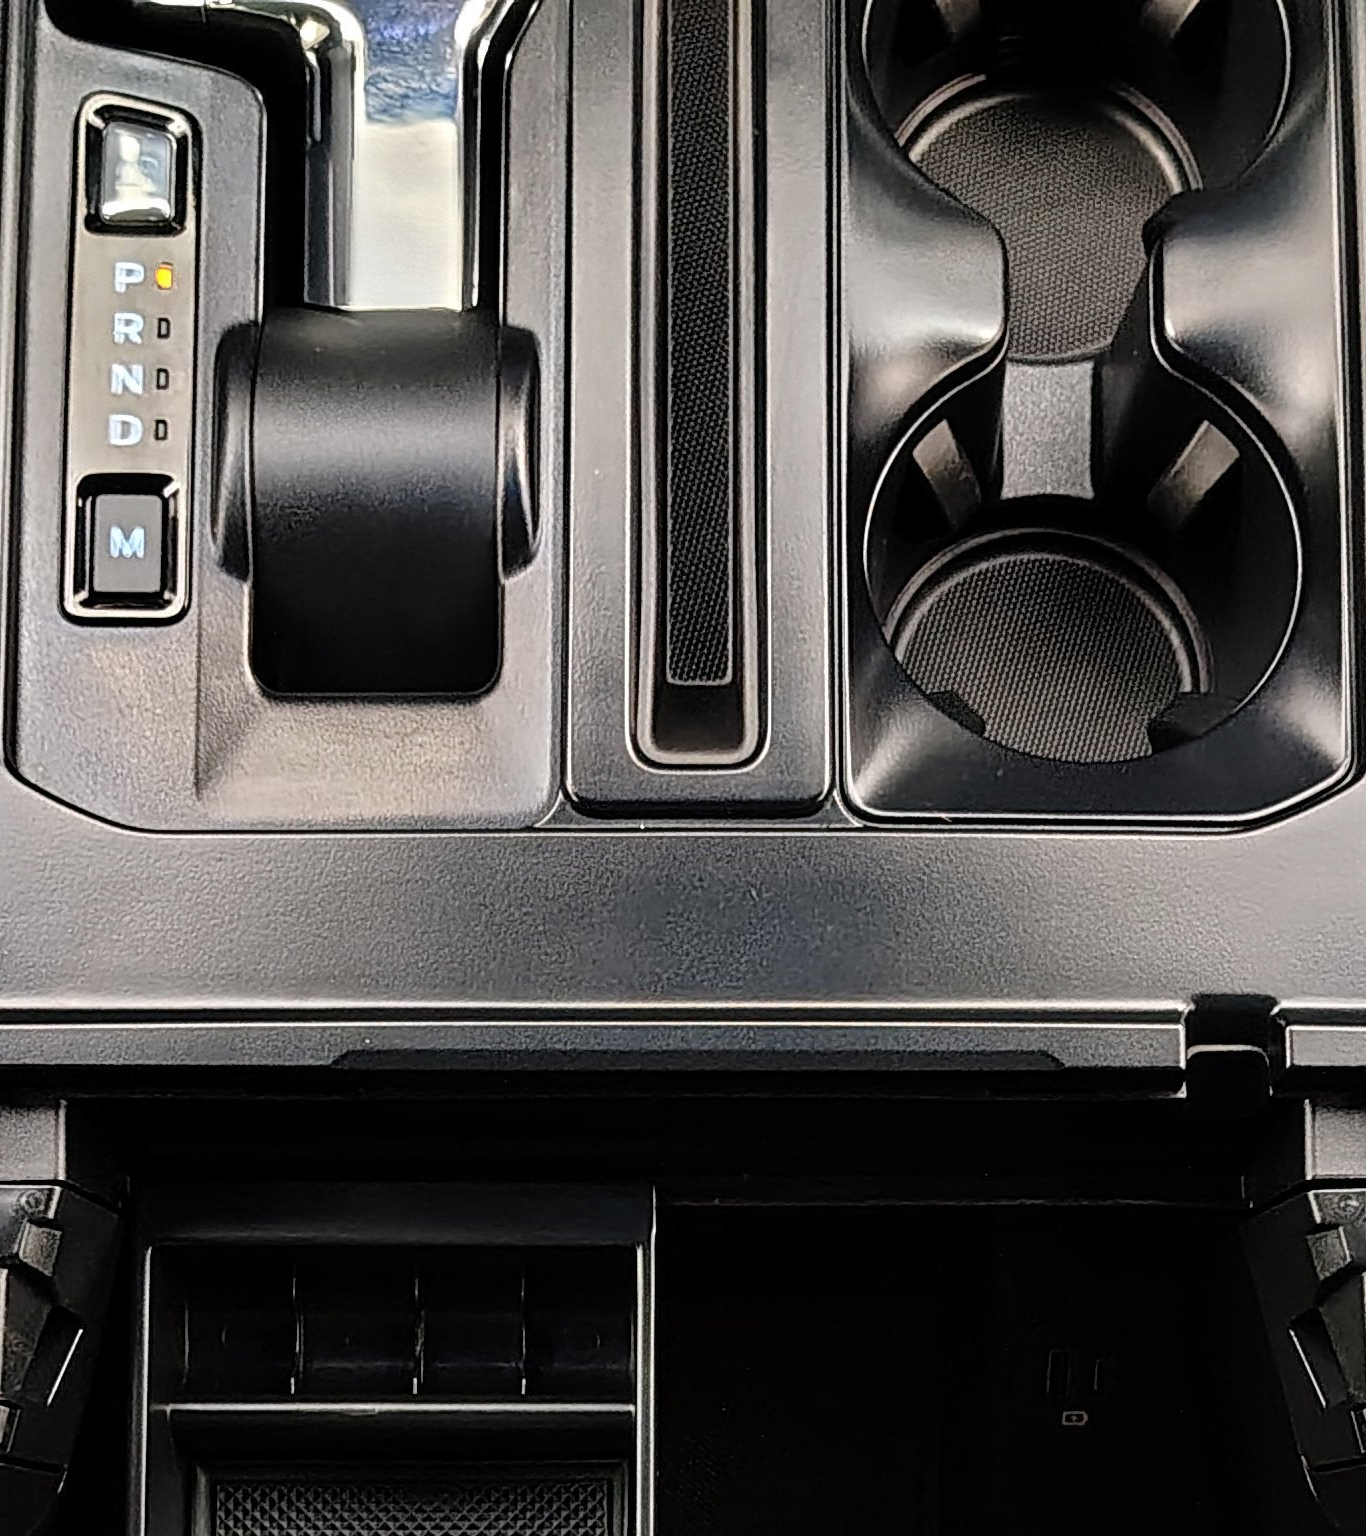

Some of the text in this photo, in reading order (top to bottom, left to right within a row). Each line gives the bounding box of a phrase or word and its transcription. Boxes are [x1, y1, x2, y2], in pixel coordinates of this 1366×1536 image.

[113, 261, 146, 294] P
[112, 312, 145, 346] R
[109, 363, 145, 396] N
[108, 414, 144, 447] D
[109, 525, 147, 559] M
